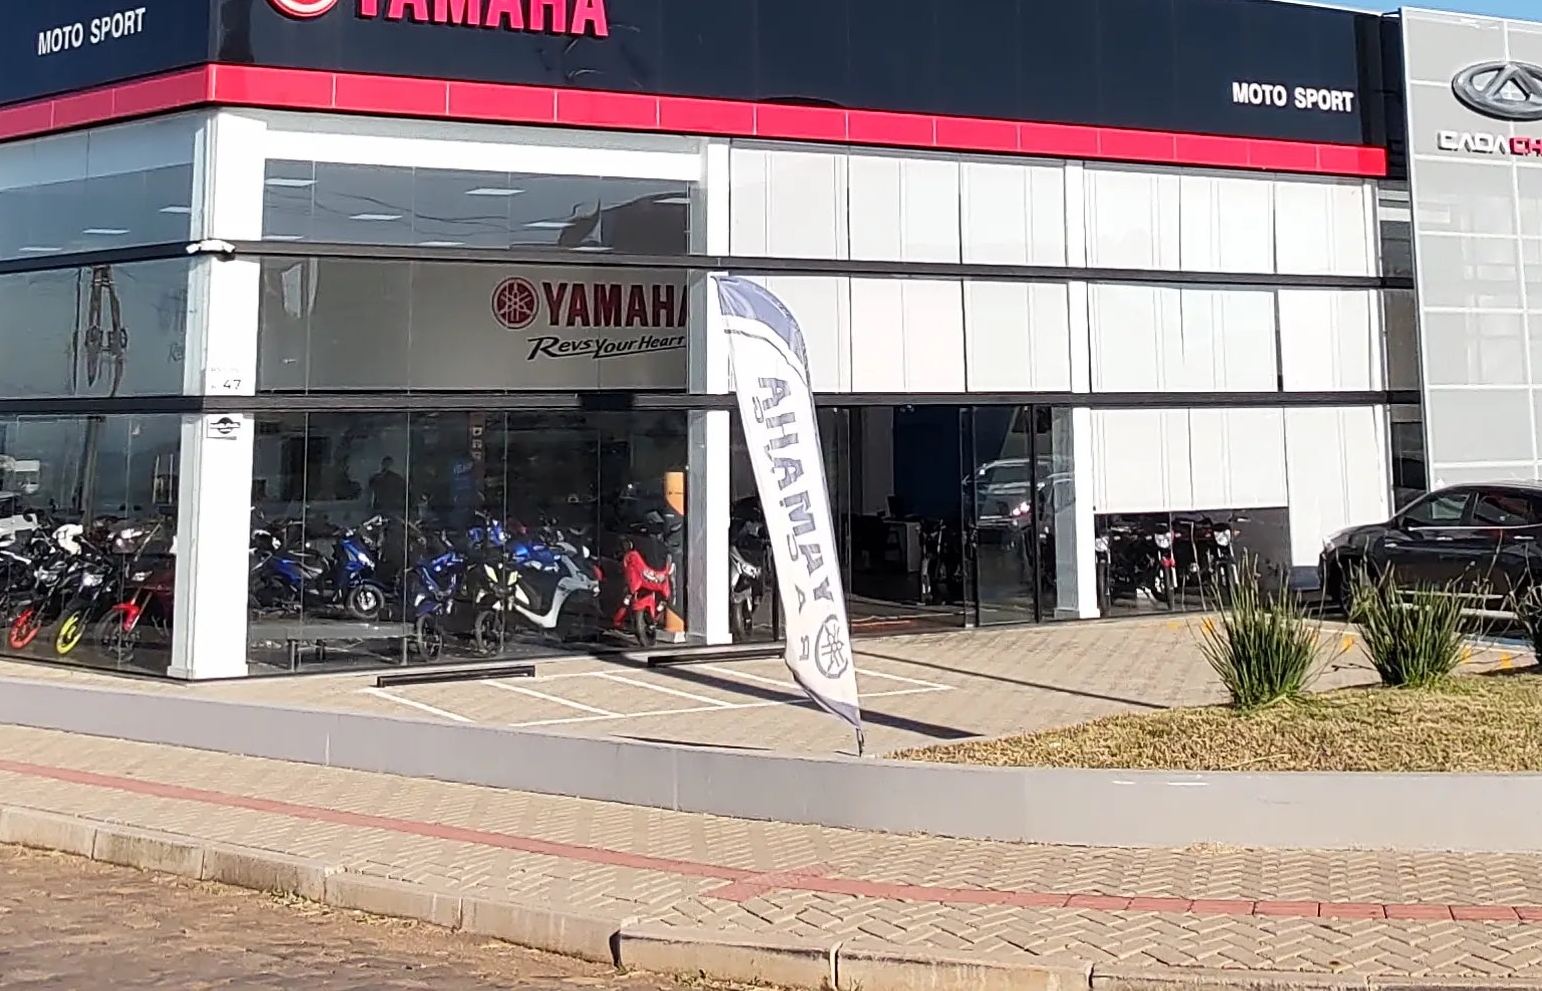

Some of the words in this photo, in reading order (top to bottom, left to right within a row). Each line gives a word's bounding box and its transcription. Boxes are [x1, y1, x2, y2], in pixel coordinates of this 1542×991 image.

[38, 22, 84, 56] MOTO
[90, 7, 146, 43] SPORT
[1232, 81, 1287, 107] MOTO
[1294, 87, 1355, 112] SPORT
[223, 379, 241, 390] 47
